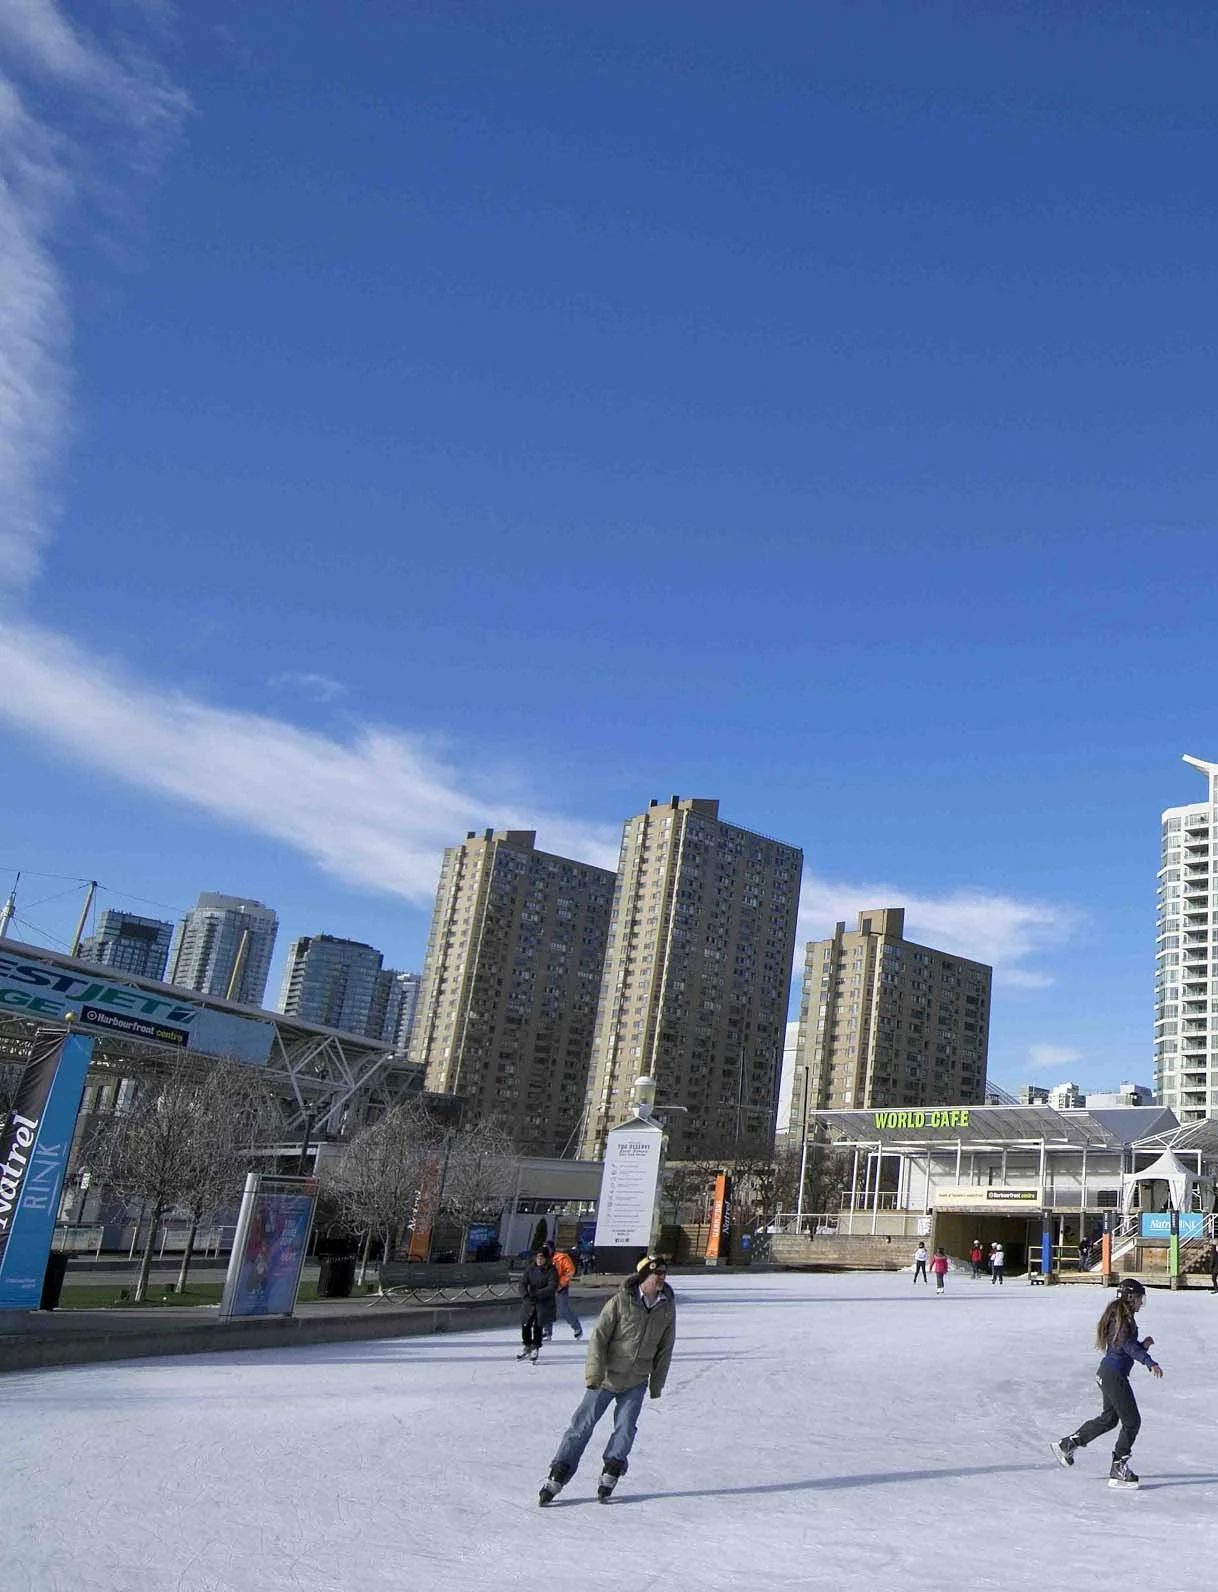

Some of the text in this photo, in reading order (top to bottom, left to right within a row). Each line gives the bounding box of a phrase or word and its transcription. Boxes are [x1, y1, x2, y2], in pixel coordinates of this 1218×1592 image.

[97, 1013, 154, 1035] Harbourfront
[874, 1109, 969, 1129] WORLD CAFE
[22, 1142, 62, 1210] RINK
